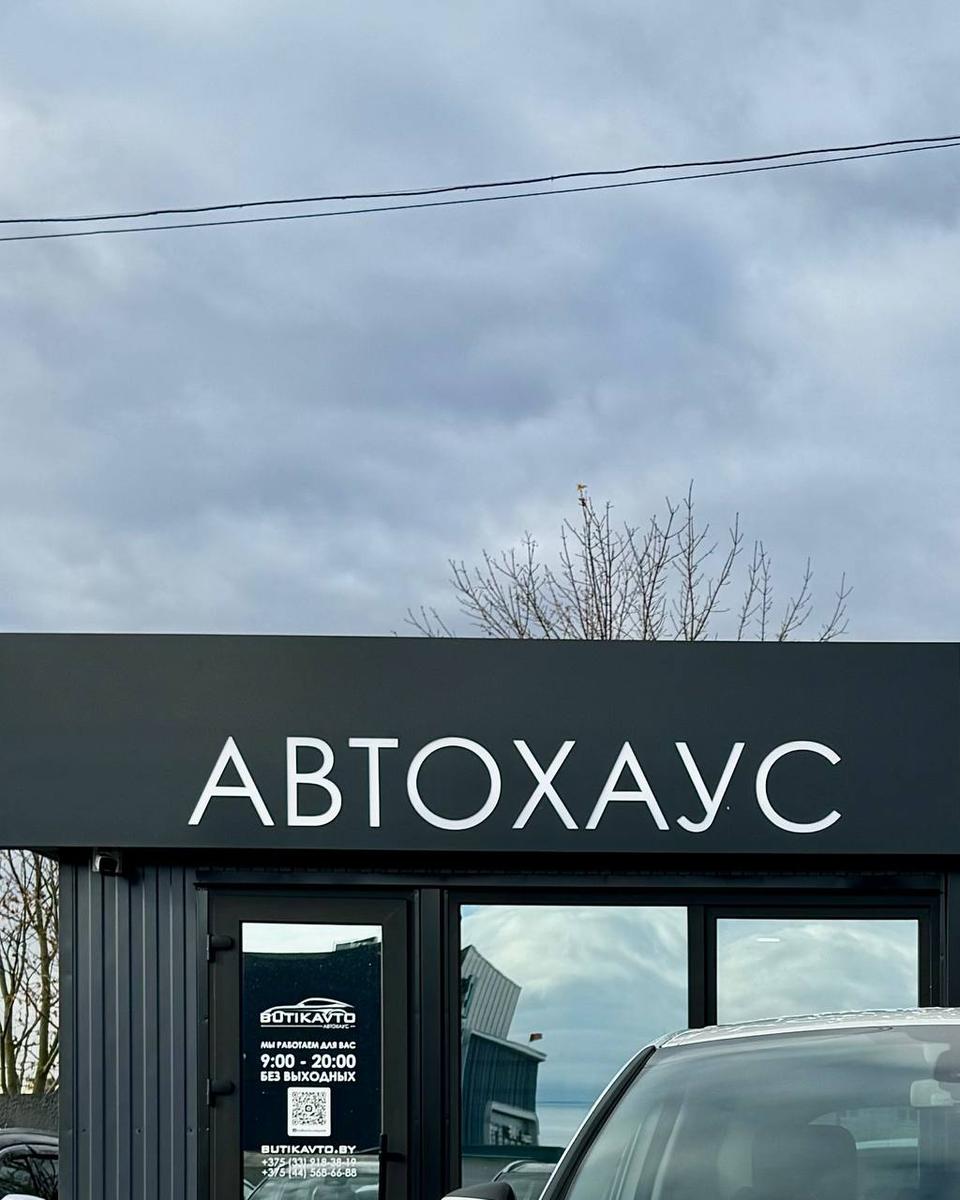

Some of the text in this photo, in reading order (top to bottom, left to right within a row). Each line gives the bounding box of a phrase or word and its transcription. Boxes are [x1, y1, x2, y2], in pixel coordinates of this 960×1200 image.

[188, 735, 842, 834] АВТОХАУС
[260, 1012, 356, 1023] BUTIKAVTO
[260, 1041, 356, 1050] МЫ РАБОТАЕМ ДЛЯ ВАС
[260, 1053, 295, 1068] 9:00
[311, 1053, 357, 1068] 20:00
[260, 1071, 356, 1083] БЕЗ ВЫХОДНЫХ
[261, 1145, 356, 1154] BUTIKAVTO.BY
[261, 1157, 357, 1168] +375 (33) 918-38-19
[261, 1167, 357, 1179] +375 (44) 568-66-88
